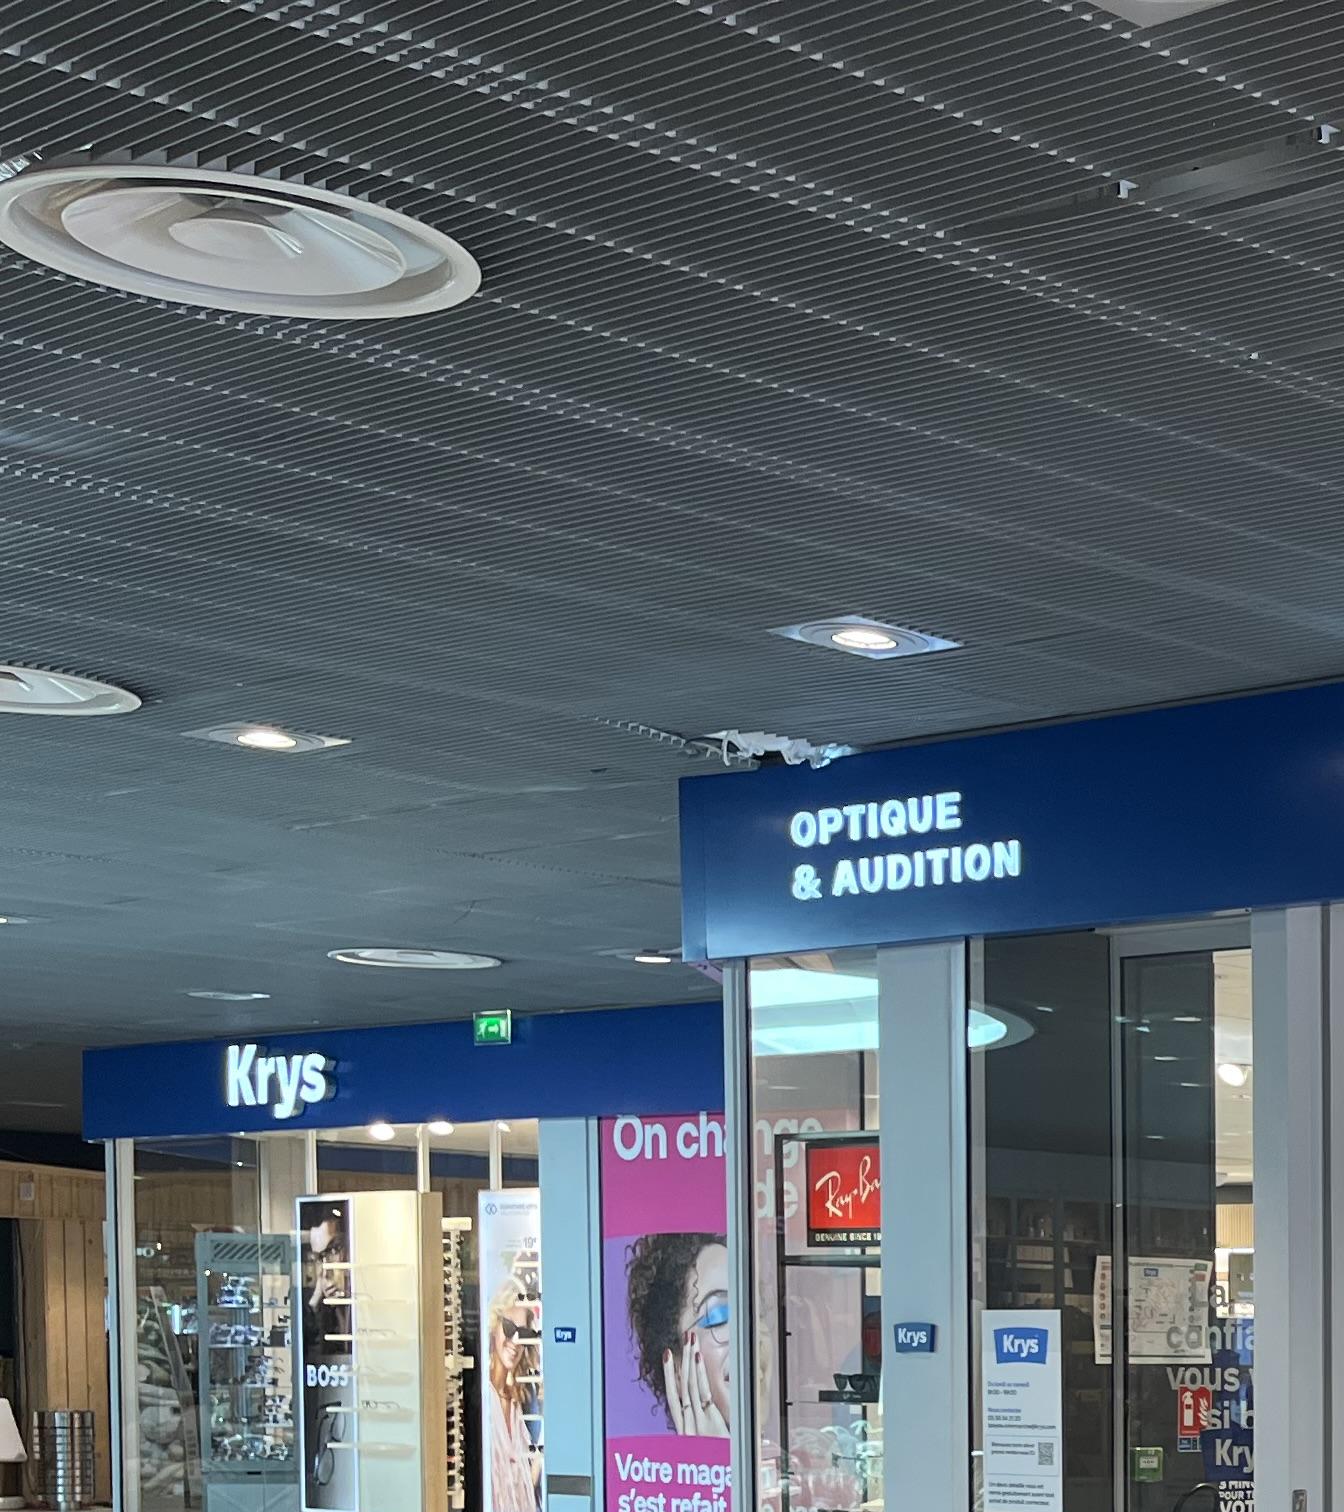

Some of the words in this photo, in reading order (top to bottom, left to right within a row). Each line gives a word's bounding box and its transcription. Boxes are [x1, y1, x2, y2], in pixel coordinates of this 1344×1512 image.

[790, 791, 963, 848] OPTIQUE
[792, 863, 823, 901] &
[831, 839, 1022, 897] AUDITION
[227, 1043, 327, 1119] Krys
[613, 1114, 668, 1161] On
[815, 1154, 881, 1220] Ray-Ba
[556, 1329, 572, 1341] Krys
[897, 1327, 928, 1347] Krys
[1002, 1333, 1039, 1358] Krys
[1166, 1318, 1255, 1350] confia
[306, 1364, 350, 1388] BOSS
[1165, 1366, 1240, 1392] vous
[614, 1452, 673, 1484] Votre
[677, 1463, 733, 1494] maga
[1215, 1439, 1255, 1474] Kry
